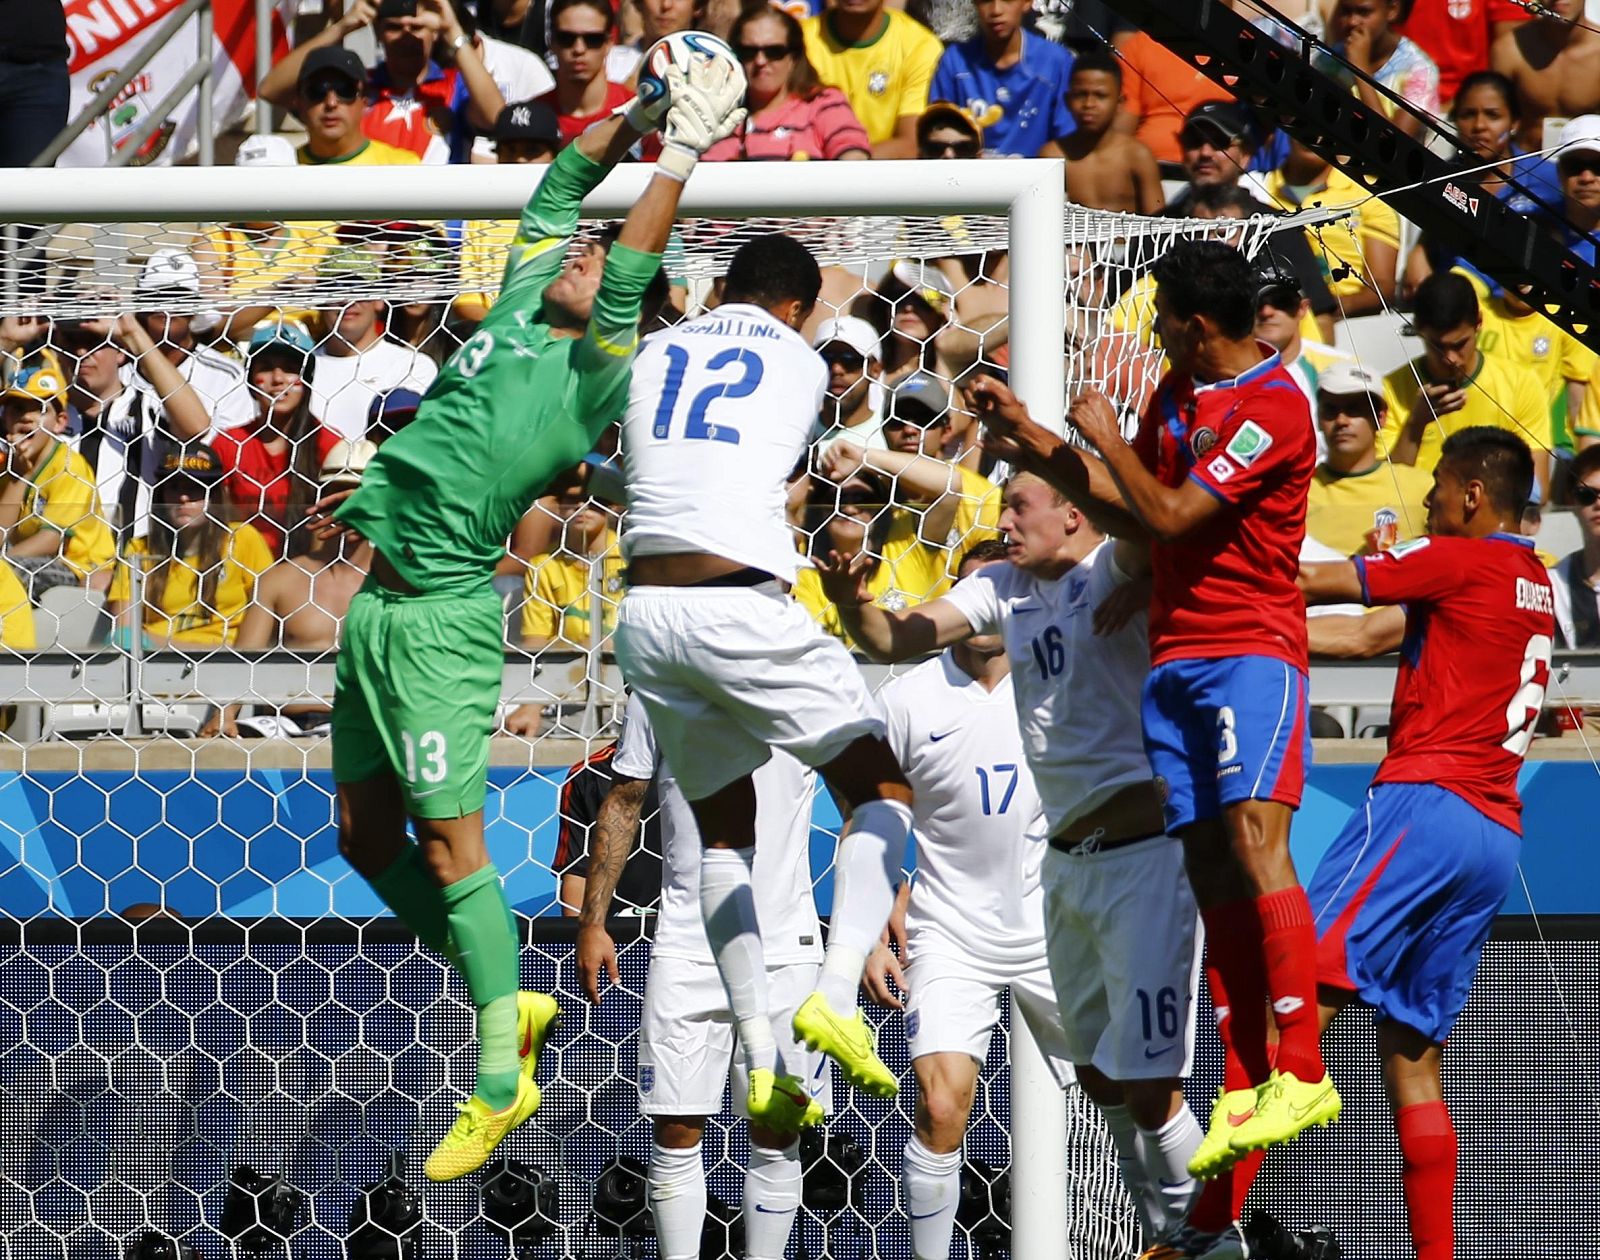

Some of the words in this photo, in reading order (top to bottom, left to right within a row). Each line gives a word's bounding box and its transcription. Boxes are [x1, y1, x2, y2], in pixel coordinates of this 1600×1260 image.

[682, 319, 781, 340] SMALLING
[652, 343, 764, 445] 12
[1515, 576, 1553, 615] DUARTE
[1031, 625, 1065, 680] 16
[401, 730, 447, 783] 13
[1216, 705, 1237, 763] 3
[975, 763, 1018, 815] 17
[1136, 986, 1178, 1040] 16
